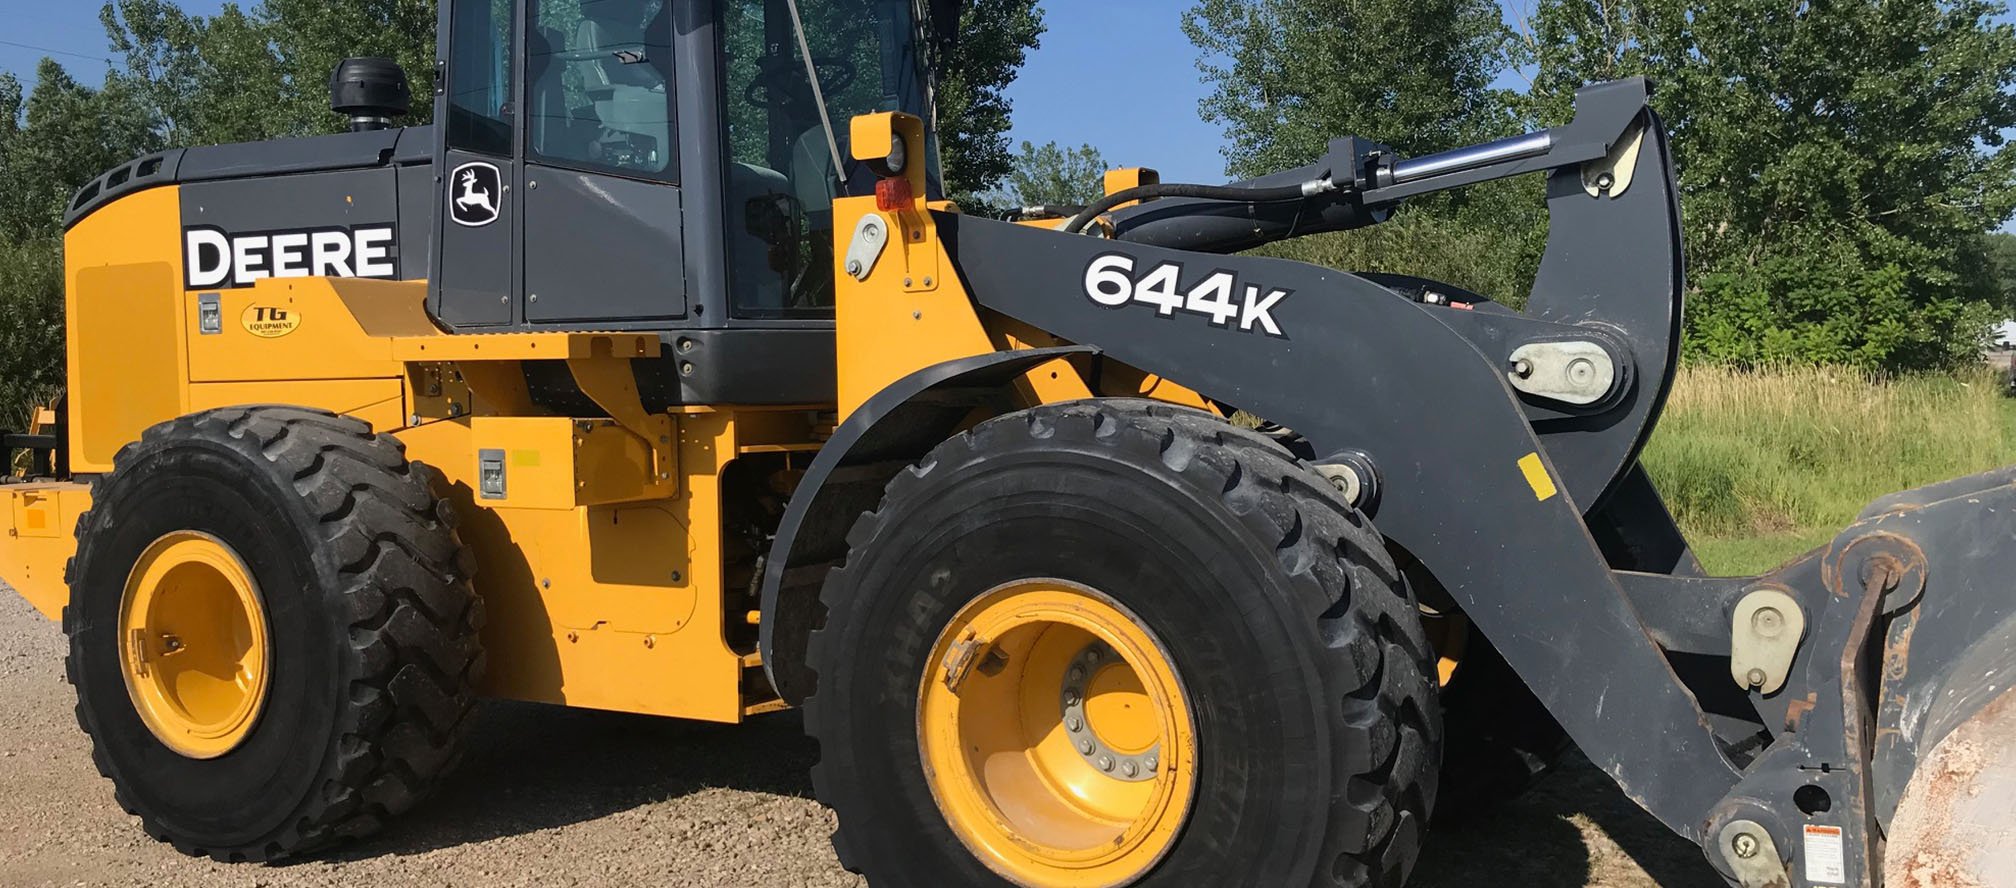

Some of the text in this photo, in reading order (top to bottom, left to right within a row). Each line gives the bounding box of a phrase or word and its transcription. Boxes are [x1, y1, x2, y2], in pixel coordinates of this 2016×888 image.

[186, 228, 394, 286] DEERE
[1085, 255, 1287, 335] 644K
[249, 322, 293, 331] EQUIPMENT
[253, 306, 287, 321] TG
